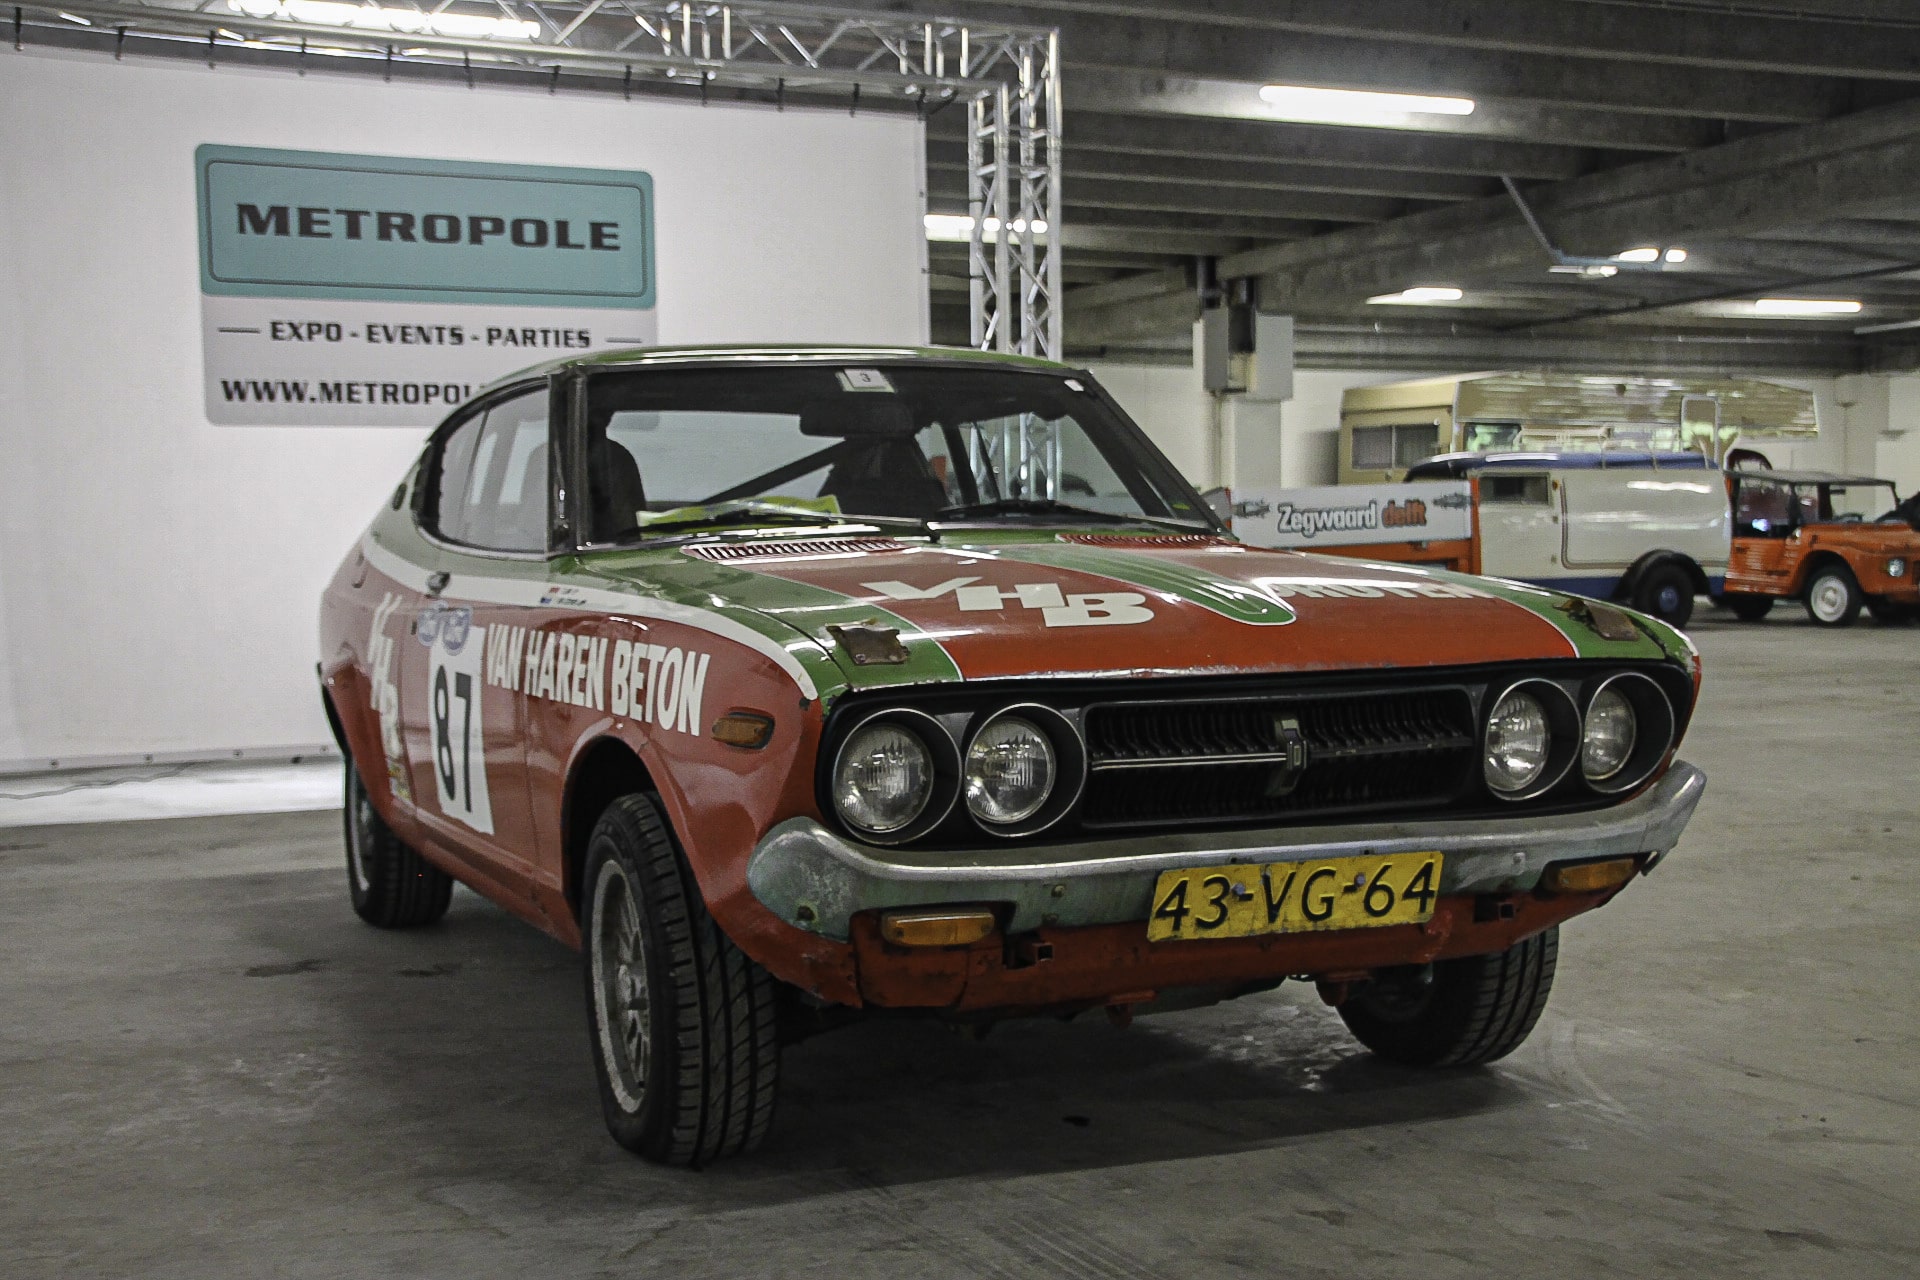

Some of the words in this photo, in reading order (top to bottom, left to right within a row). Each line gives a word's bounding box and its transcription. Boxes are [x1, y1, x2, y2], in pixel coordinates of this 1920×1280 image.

[236, 203, 621, 251] METROPOLE
[270, 321, 342, 343] EXPO
[366, 323, 464, 346] EVENTS
[487, 327, 592, 348] PARTIES
[1278, 500, 1377, 538] Zegwaard
[859, 576, 1155, 627] VHB
[487, 622, 526, 691] VAN
[524, 629, 609, 711] HAREN
[611, 639, 710, 737] BETON
[434, 664, 473, 813] 87
[1154, 861, 1435, 932] 43-VG-64
